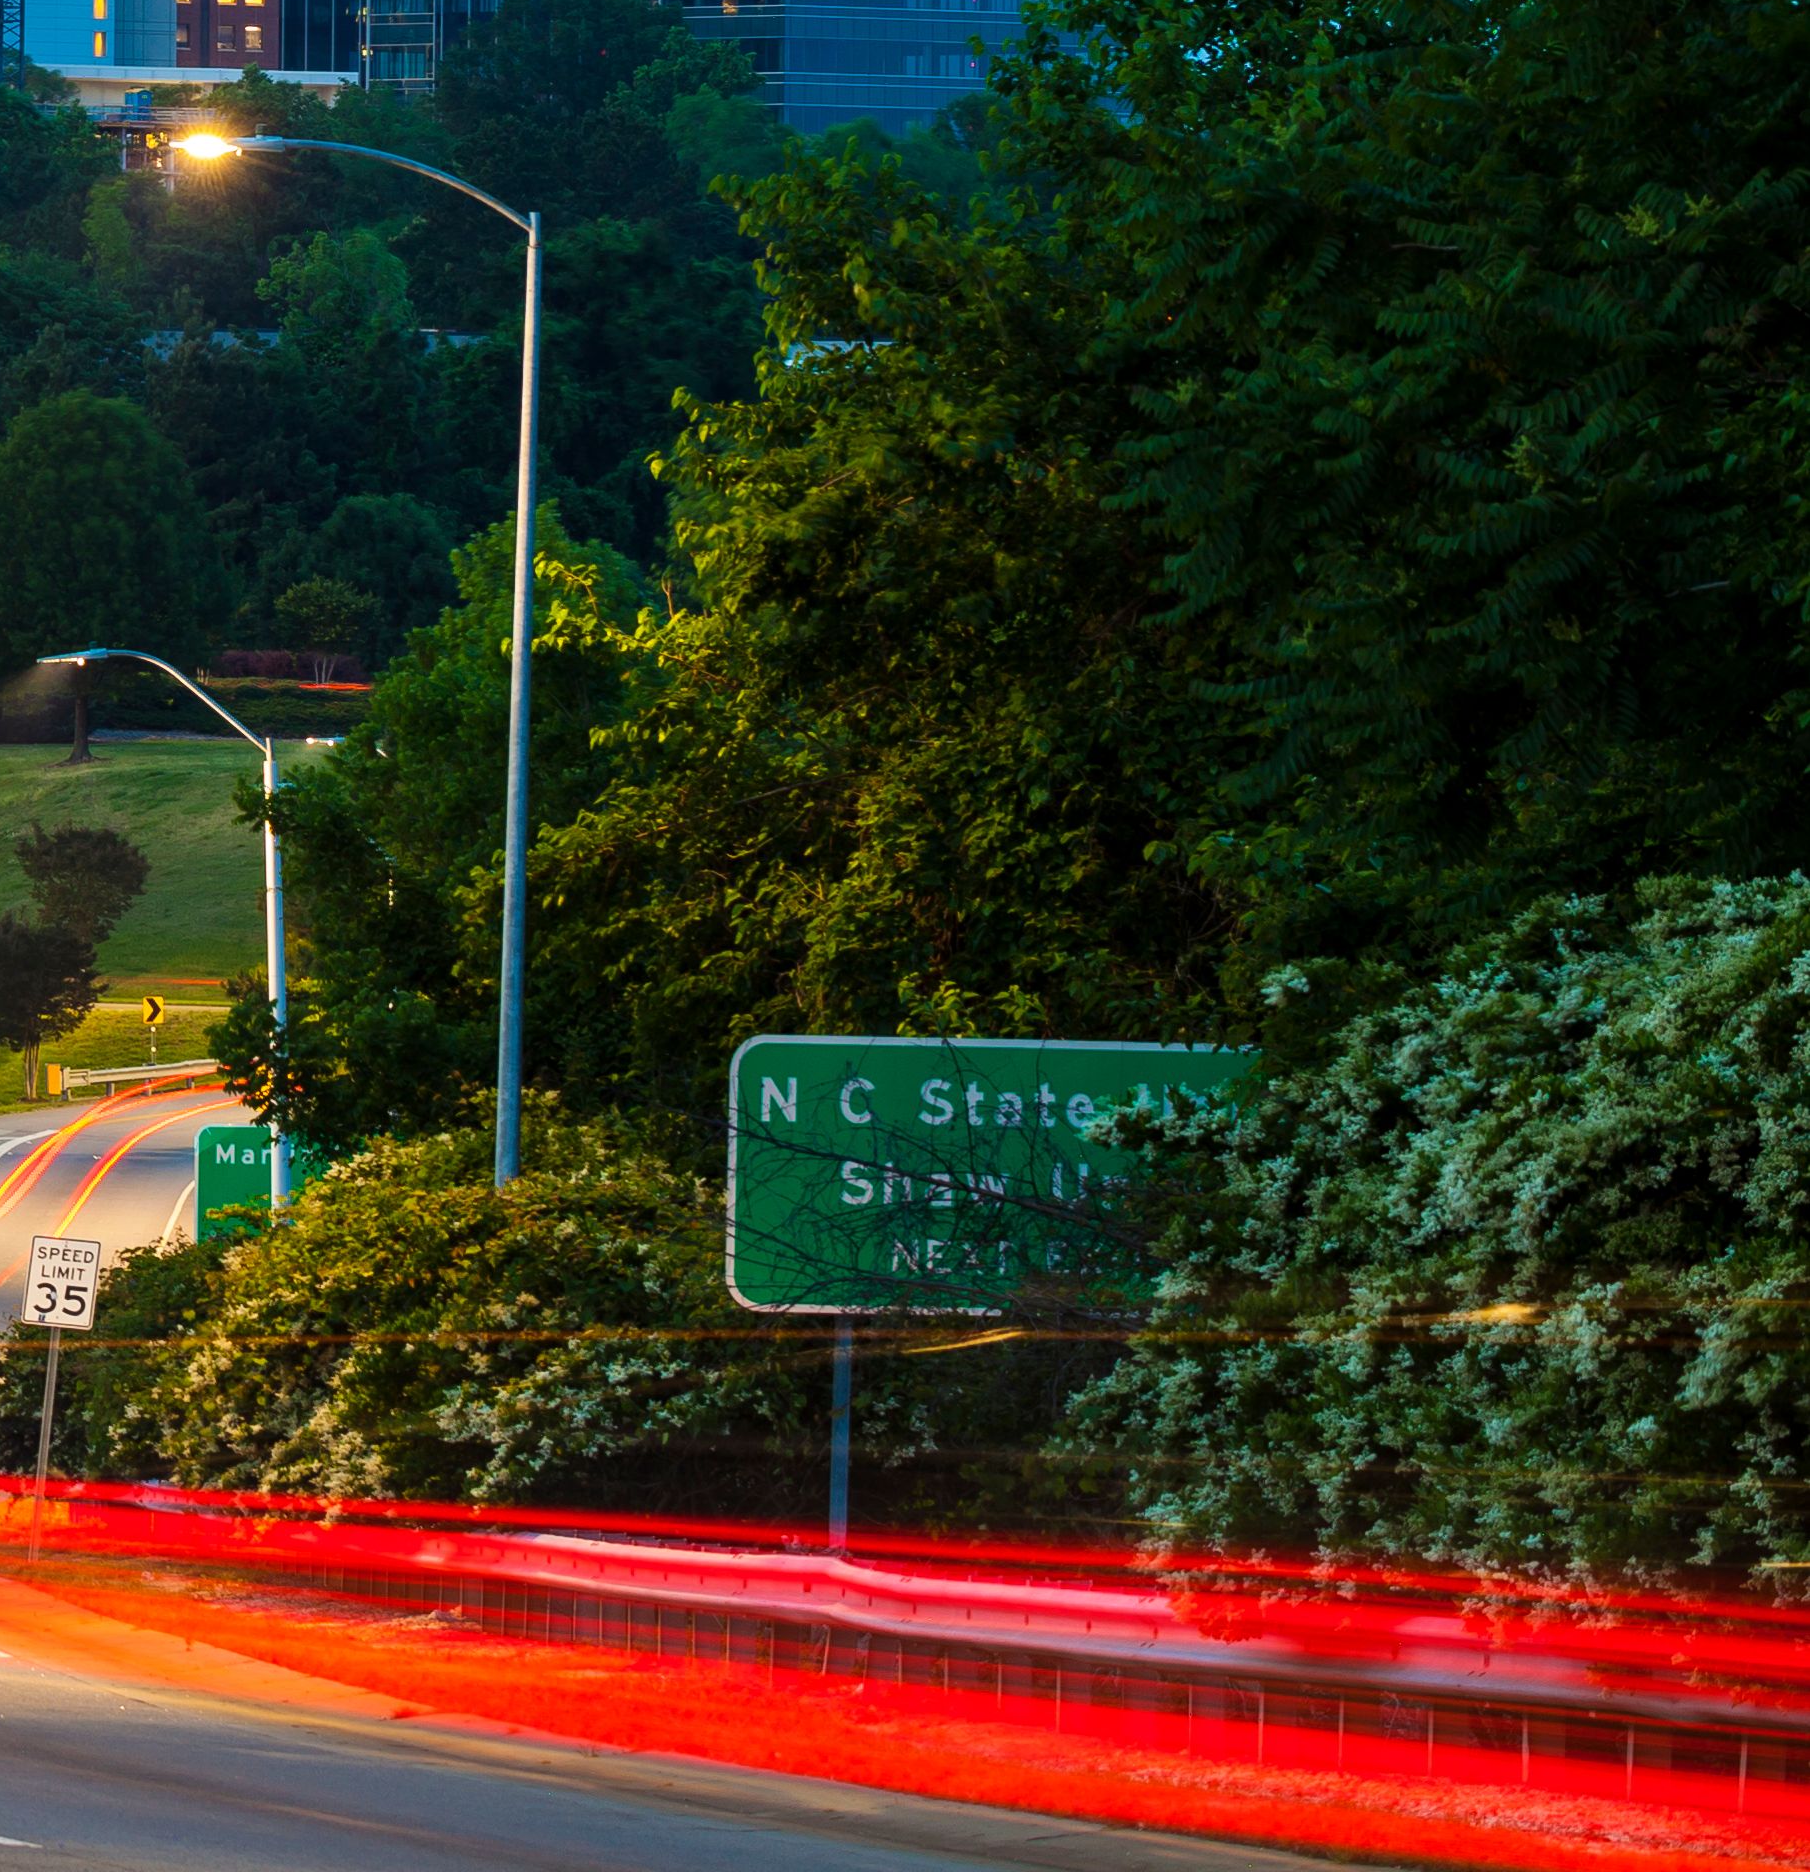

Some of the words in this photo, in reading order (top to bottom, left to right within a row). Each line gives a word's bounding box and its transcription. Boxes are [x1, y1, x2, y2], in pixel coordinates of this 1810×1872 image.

[760, 1076, 797, 1123] N
[840, 1077, 876, 1124] C
[917, 1078, 1097, 1129] State
[37, 1246, 95, 1264] SPEED
[41, 1264, 86, 1281] LIMIT
[33, 1282, 88, 1317] 35
